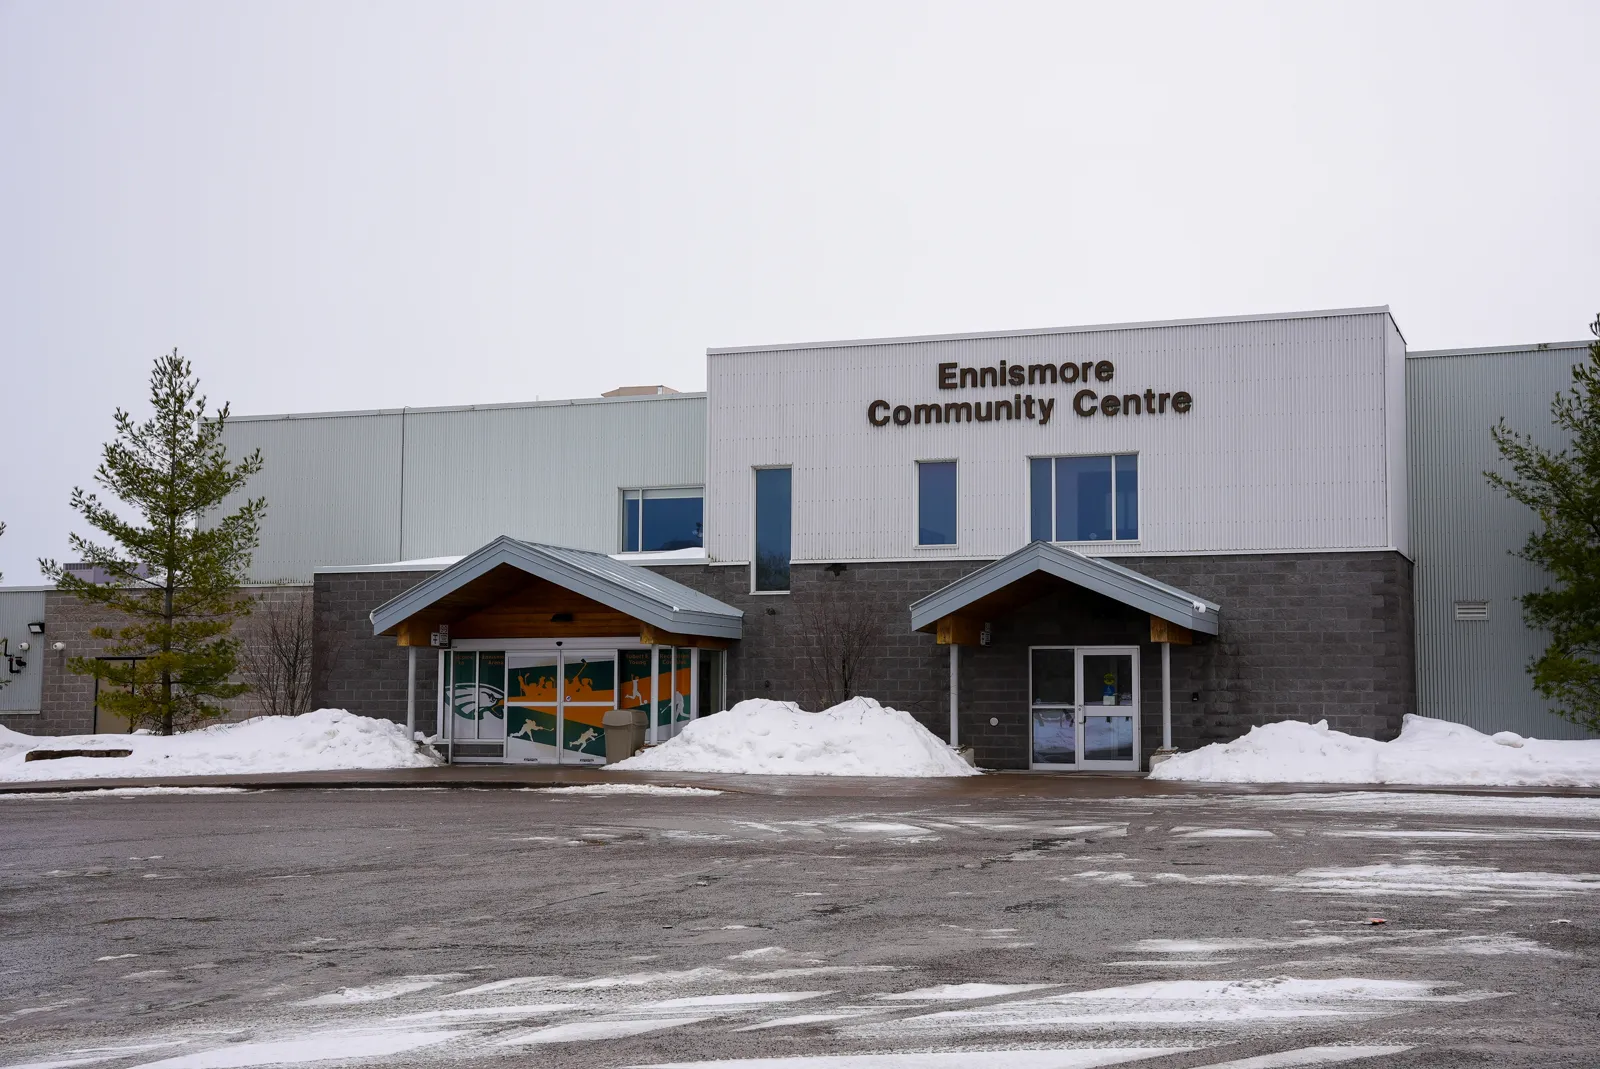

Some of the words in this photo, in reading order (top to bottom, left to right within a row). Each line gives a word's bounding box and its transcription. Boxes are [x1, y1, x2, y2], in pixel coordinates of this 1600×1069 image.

[938, 360, 1115, 390] Ennismore
[867, 393, 1055, 426] Community
[1073, 388, 1193, 418] Centre
